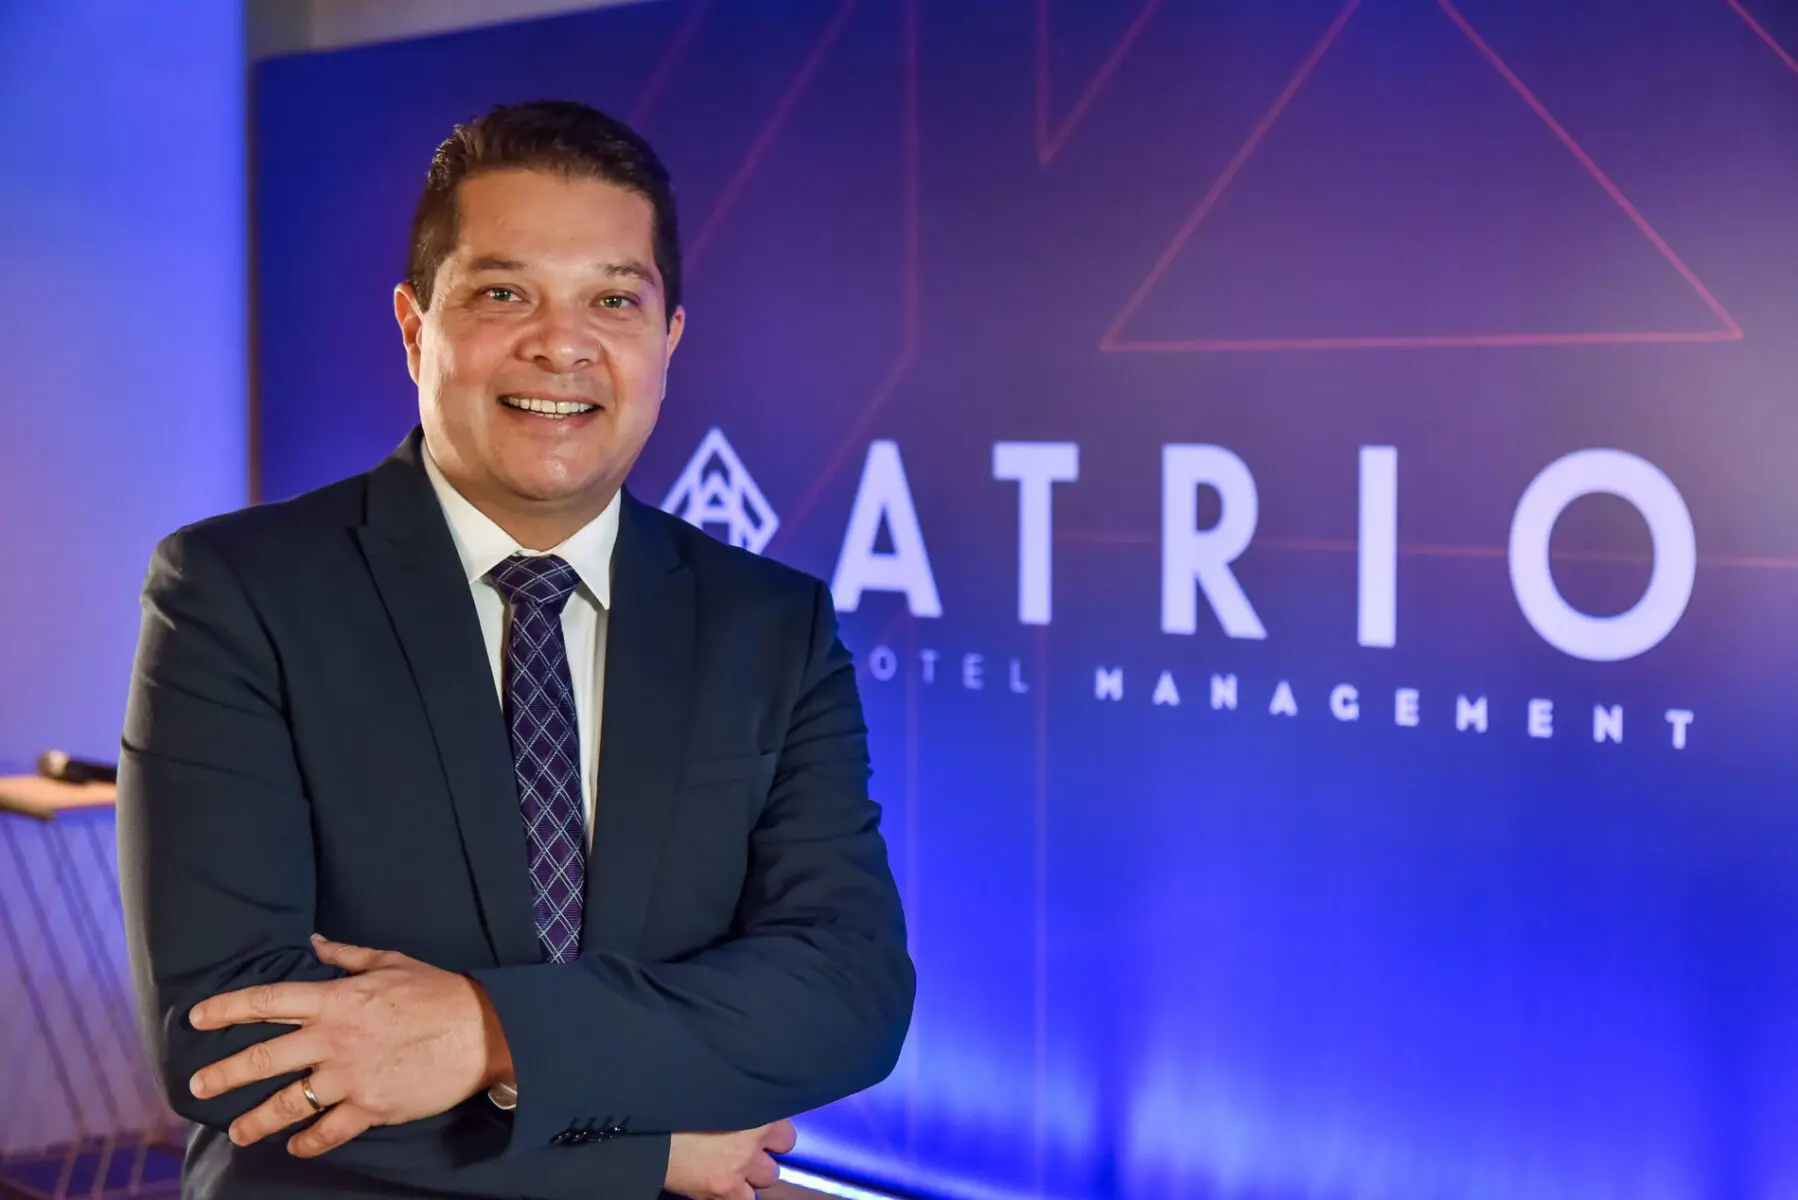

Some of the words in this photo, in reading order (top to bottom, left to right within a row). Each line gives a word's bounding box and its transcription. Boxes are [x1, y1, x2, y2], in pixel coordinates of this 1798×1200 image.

[832, 439, 1697, 662] ATRIO
[869, 644, 1030, 694] OTEL
[1094, 666, 1694, 749] MANAGEMENT
